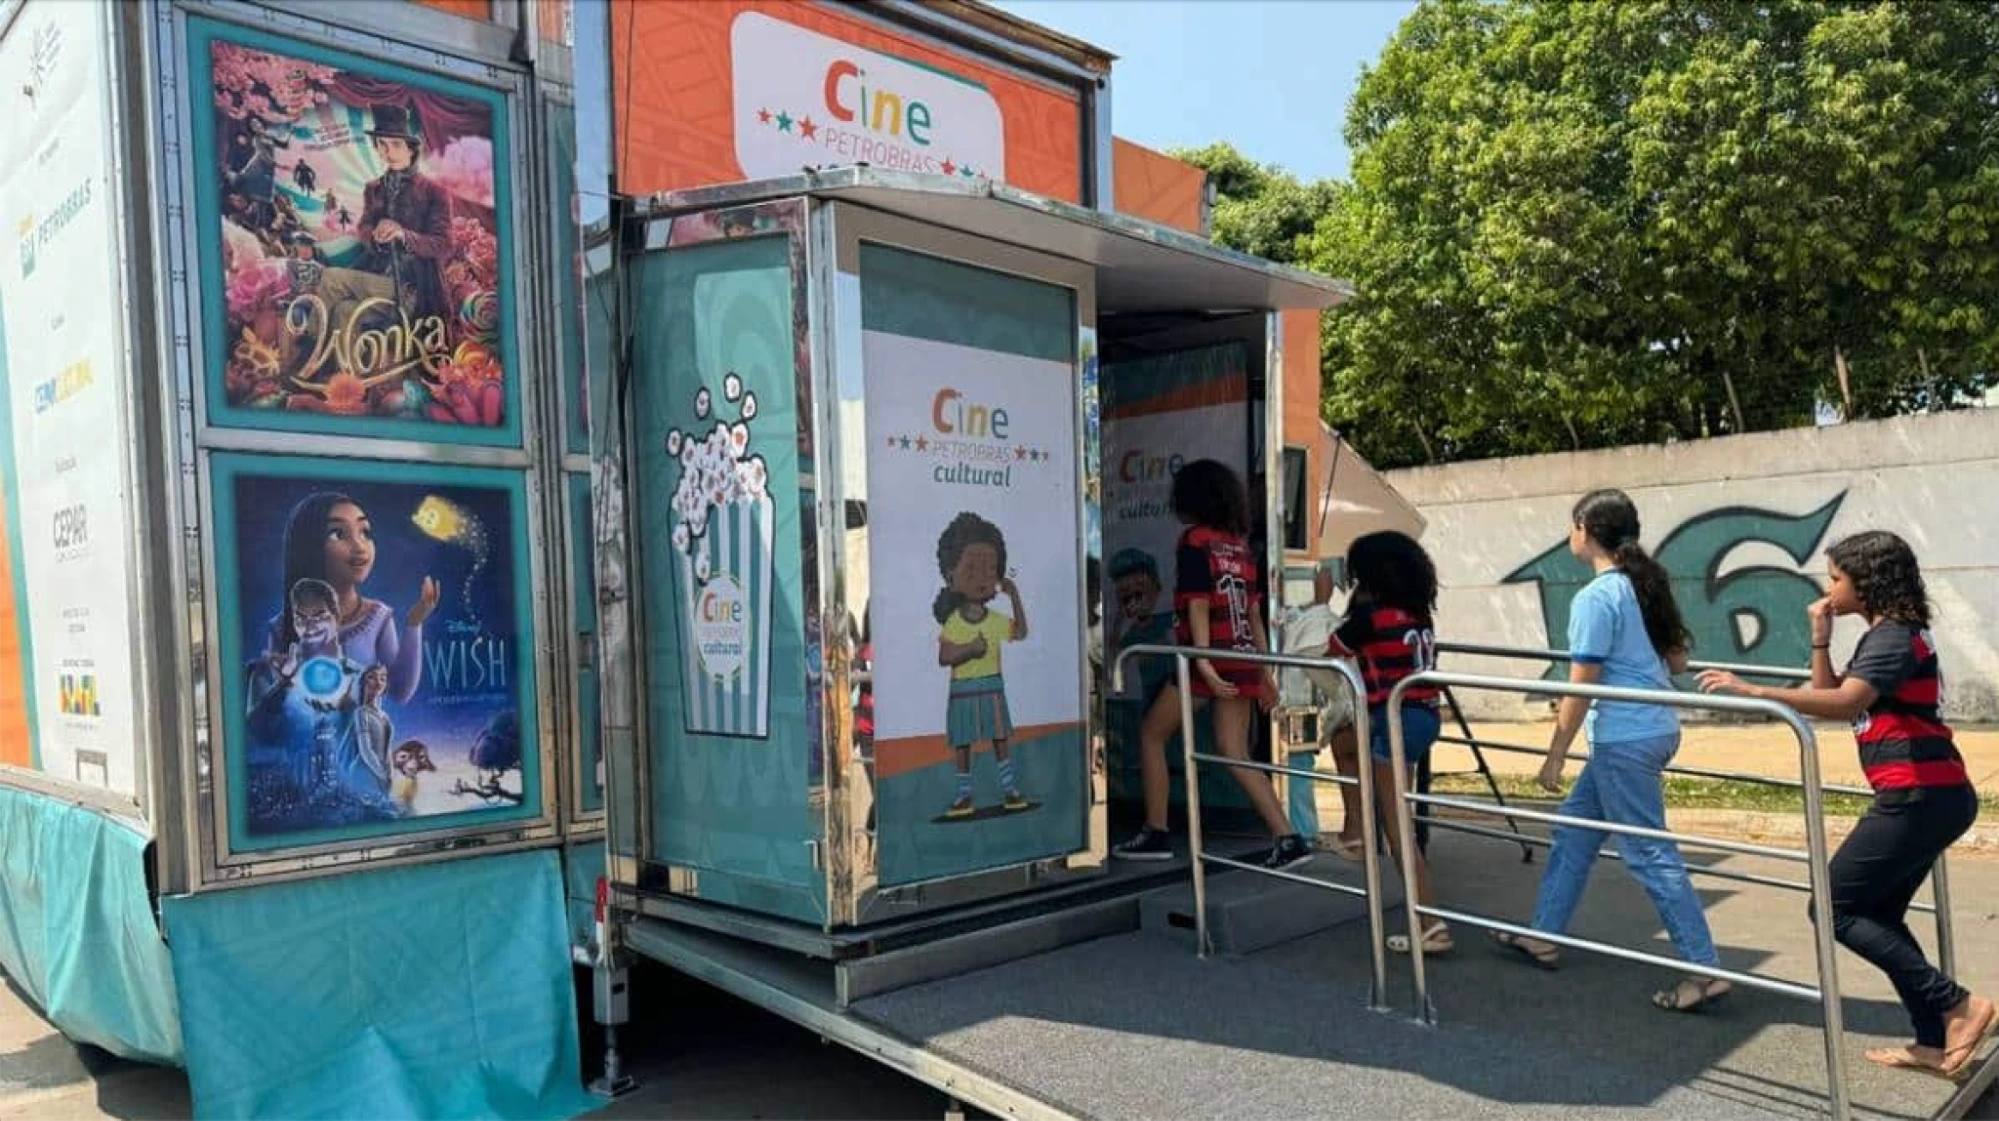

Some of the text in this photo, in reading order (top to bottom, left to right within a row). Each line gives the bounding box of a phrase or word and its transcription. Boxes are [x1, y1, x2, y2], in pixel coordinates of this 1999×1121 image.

[824, 60, 931, 146] Cine
[825, 127, 933, 173] PETROBRAS
[38, 177, 92, 250] PETROBRAS
[286, 294, 453, 392] Wonka
[933, 387, 1009, 439] Cine
[933, 461, 1011, 487] cultural
[703, 592, 742, 622] Cine
[424, 636, 506, 690] WISH
